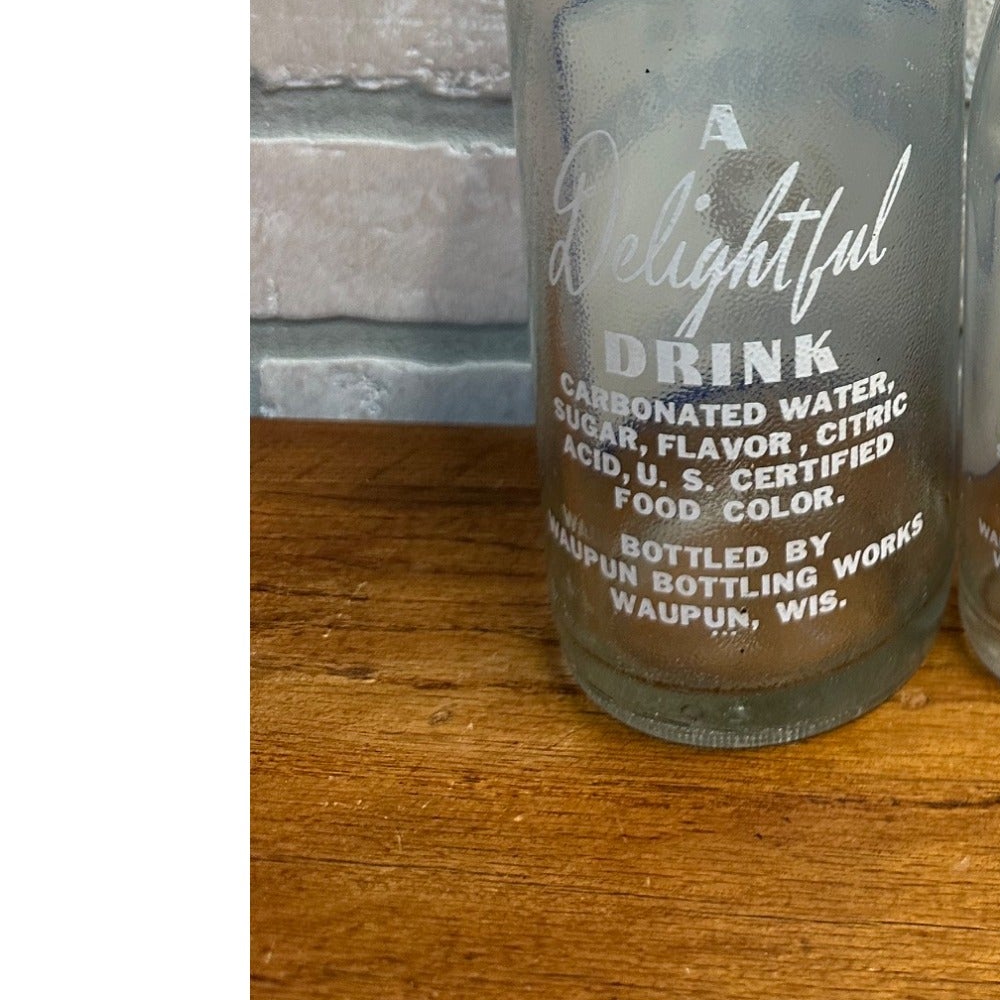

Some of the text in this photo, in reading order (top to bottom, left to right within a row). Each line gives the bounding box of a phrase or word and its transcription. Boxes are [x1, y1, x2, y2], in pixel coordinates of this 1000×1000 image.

[700, 104, 747, 150] A
[549, 130, 912, 337] Delightful
[605, 330, 839, 386] DRINK
[553, 397, 648, 457] SUGAR,
[815, 392, 908, 447] CITRIC
[560, 370, 895, 427] CARBONATED WATER,
[729, 432, 894, 491] CERTIFIED
[614, 486, 701, 520] FOOD
[723, 484, 845, 523] COLOR.
[547, 508, 638, 588] WAUPUN
[652, 566, 818, 599] BOTTLING
[832, 511, 925, 579] WORKS
[620, 531, 832, 569] BOTTLED BY
[609, 587, 847, 631] WAUPUN, WIS.
